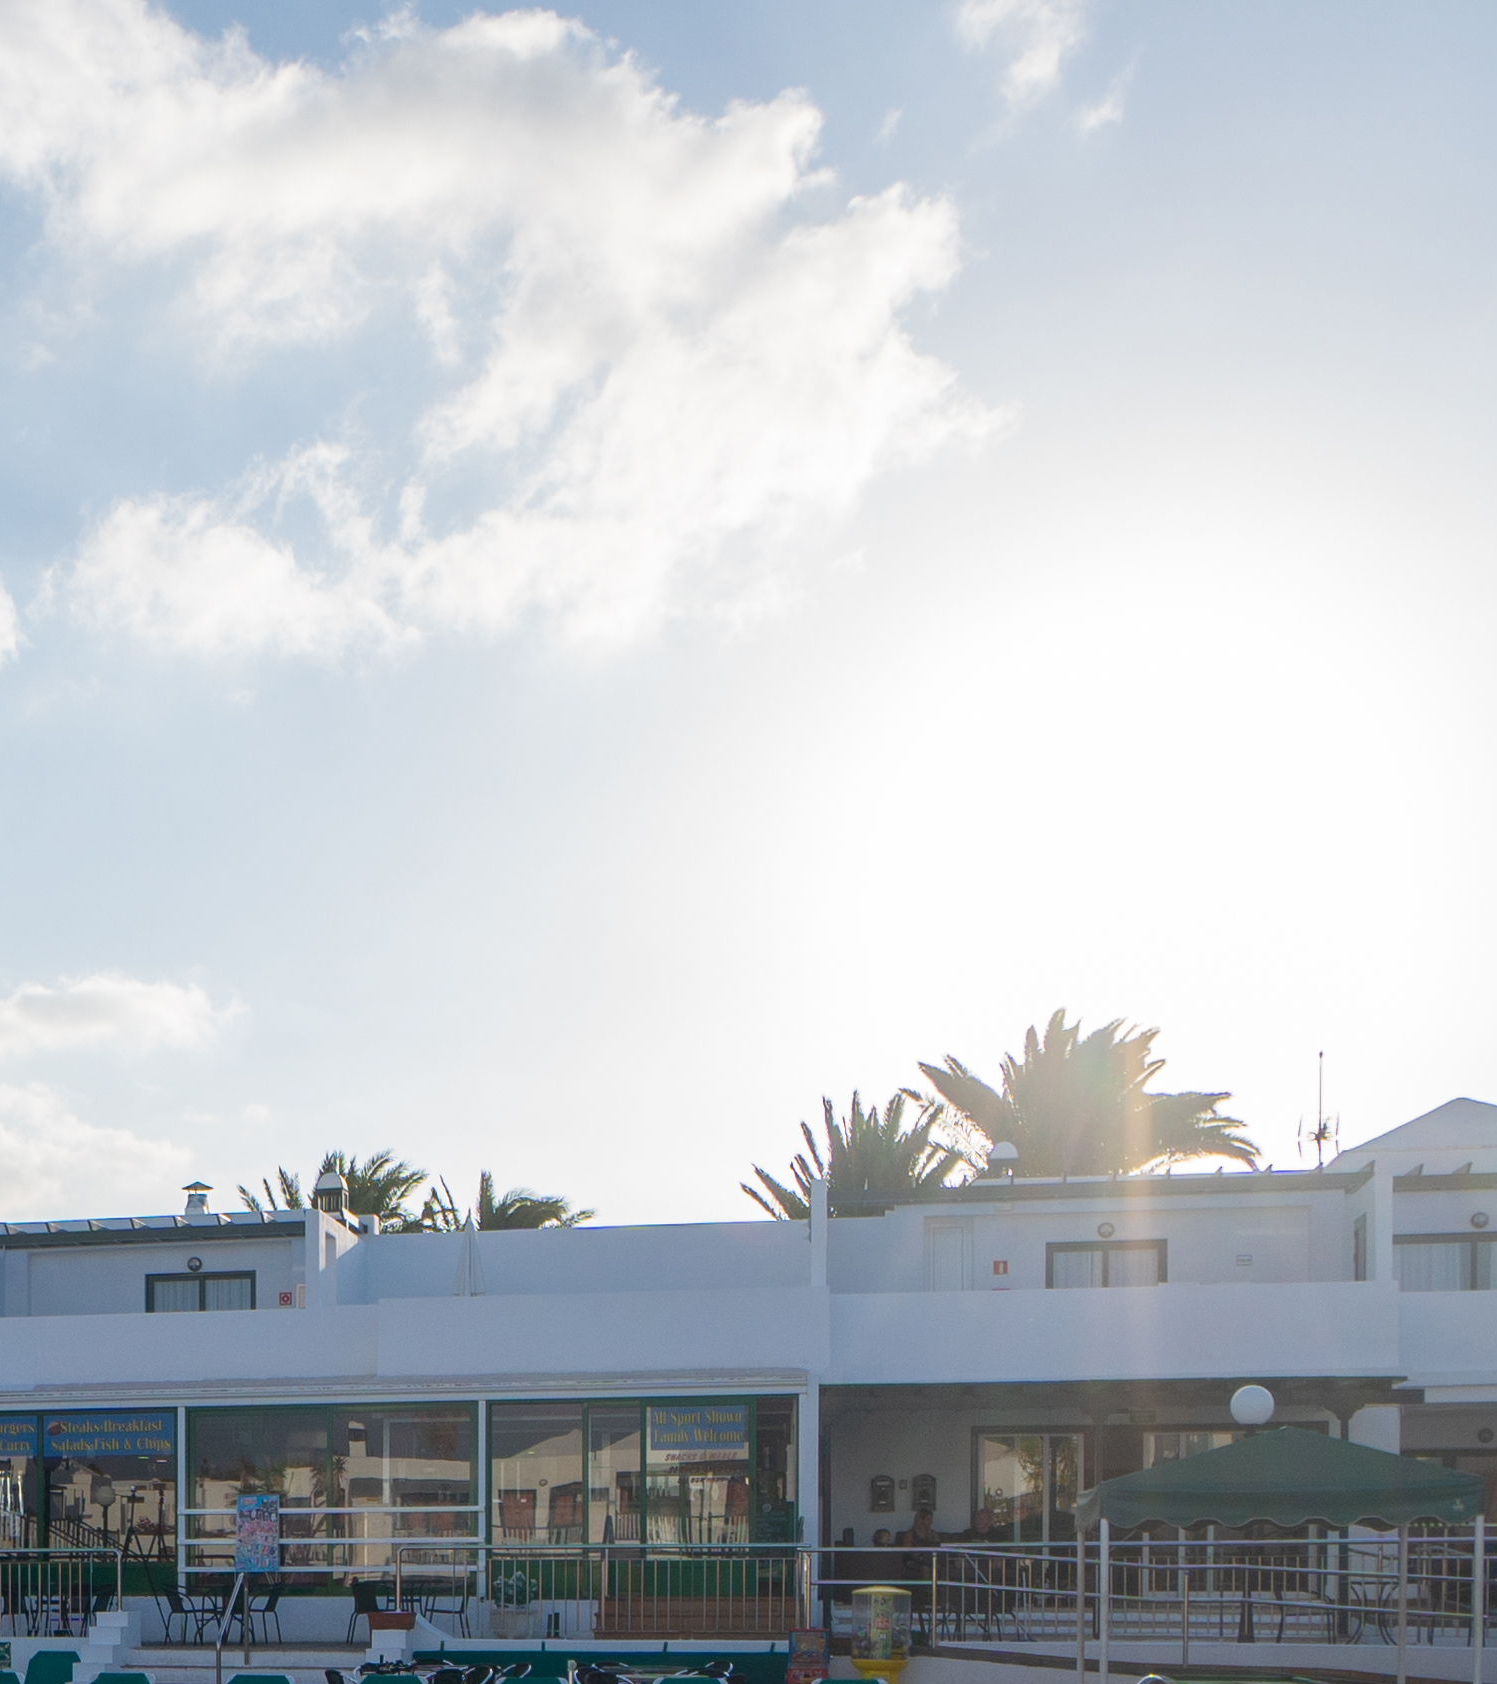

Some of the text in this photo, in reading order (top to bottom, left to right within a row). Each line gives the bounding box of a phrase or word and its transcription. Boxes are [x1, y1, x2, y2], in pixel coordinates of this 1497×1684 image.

[654, 1410, 742, 1427] All Sport Shown
[654, 1428, 743, 1443] Family Welcome
[124, 1438, 132, 1450] &
[136, 1437, 171, 1452] Chips
